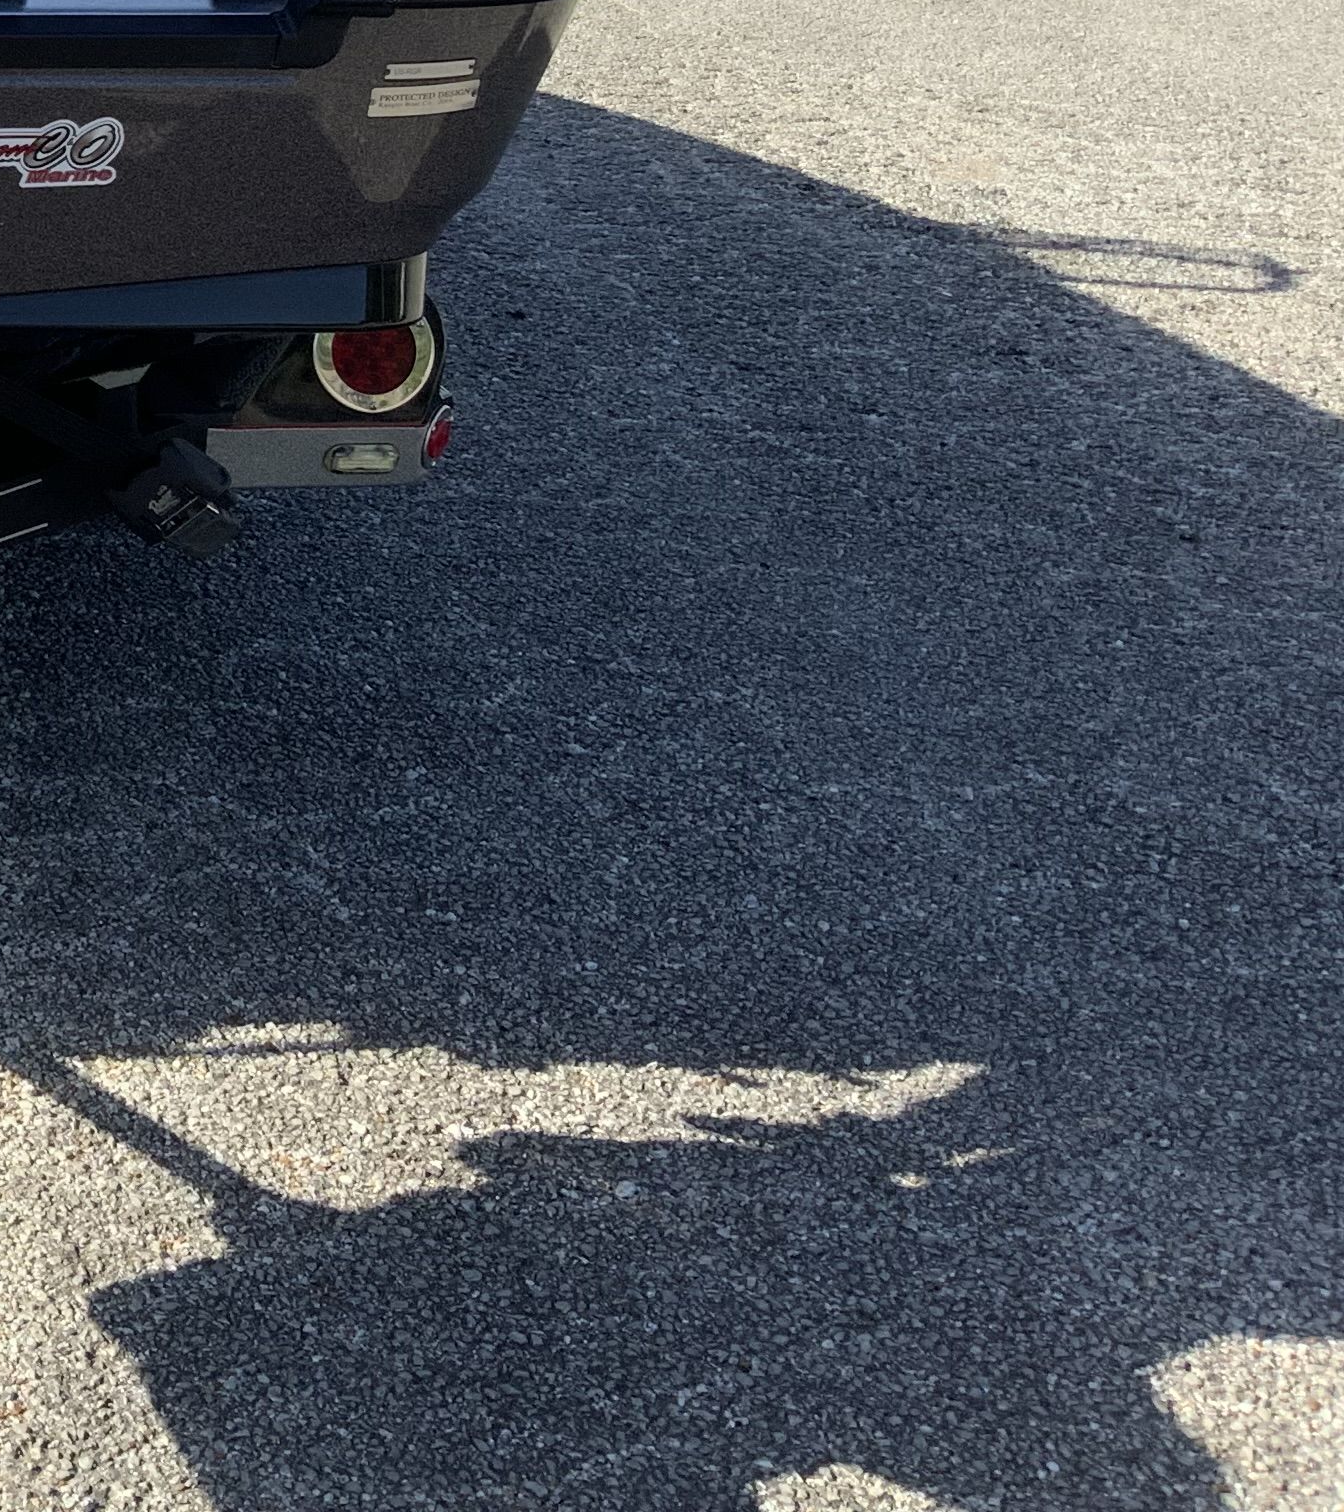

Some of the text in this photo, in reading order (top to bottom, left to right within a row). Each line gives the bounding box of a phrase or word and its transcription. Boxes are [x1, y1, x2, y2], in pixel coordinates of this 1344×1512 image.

[379, 91, 436, 102] PROTECTED
[437, 88, 472, 100] DESIGN
[26, 169, 113, 184] Marine
